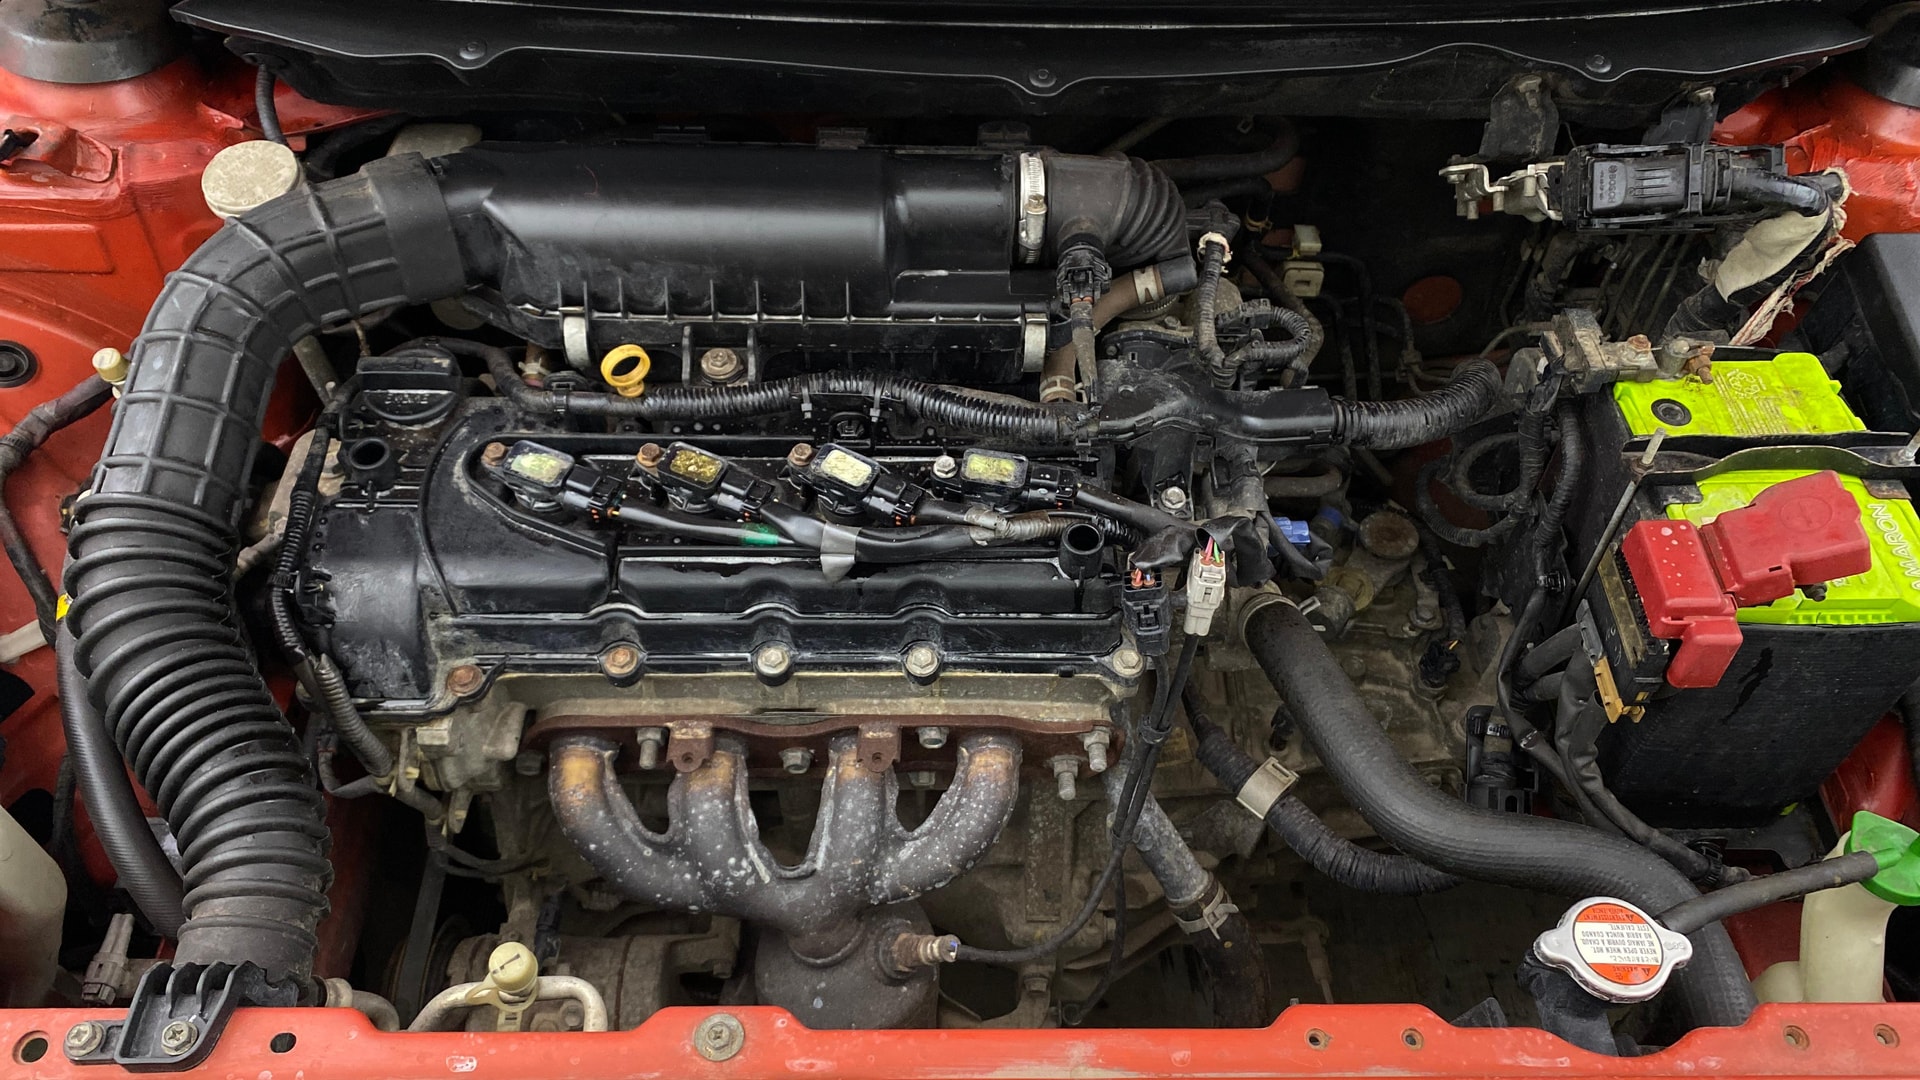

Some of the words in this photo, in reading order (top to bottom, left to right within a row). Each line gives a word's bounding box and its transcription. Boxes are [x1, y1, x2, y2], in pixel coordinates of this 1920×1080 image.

[1608, 174, 1616, 203] BOSCH
[1581, 930, 1604, 938] CUANDO
[1627, 939, 1646, 947] JAMAIS
[1647, 939, 1654, 947] NE
[1605, 946, 1622, 954] WHEN
[1639, 947, 1657, 955] NEVER
